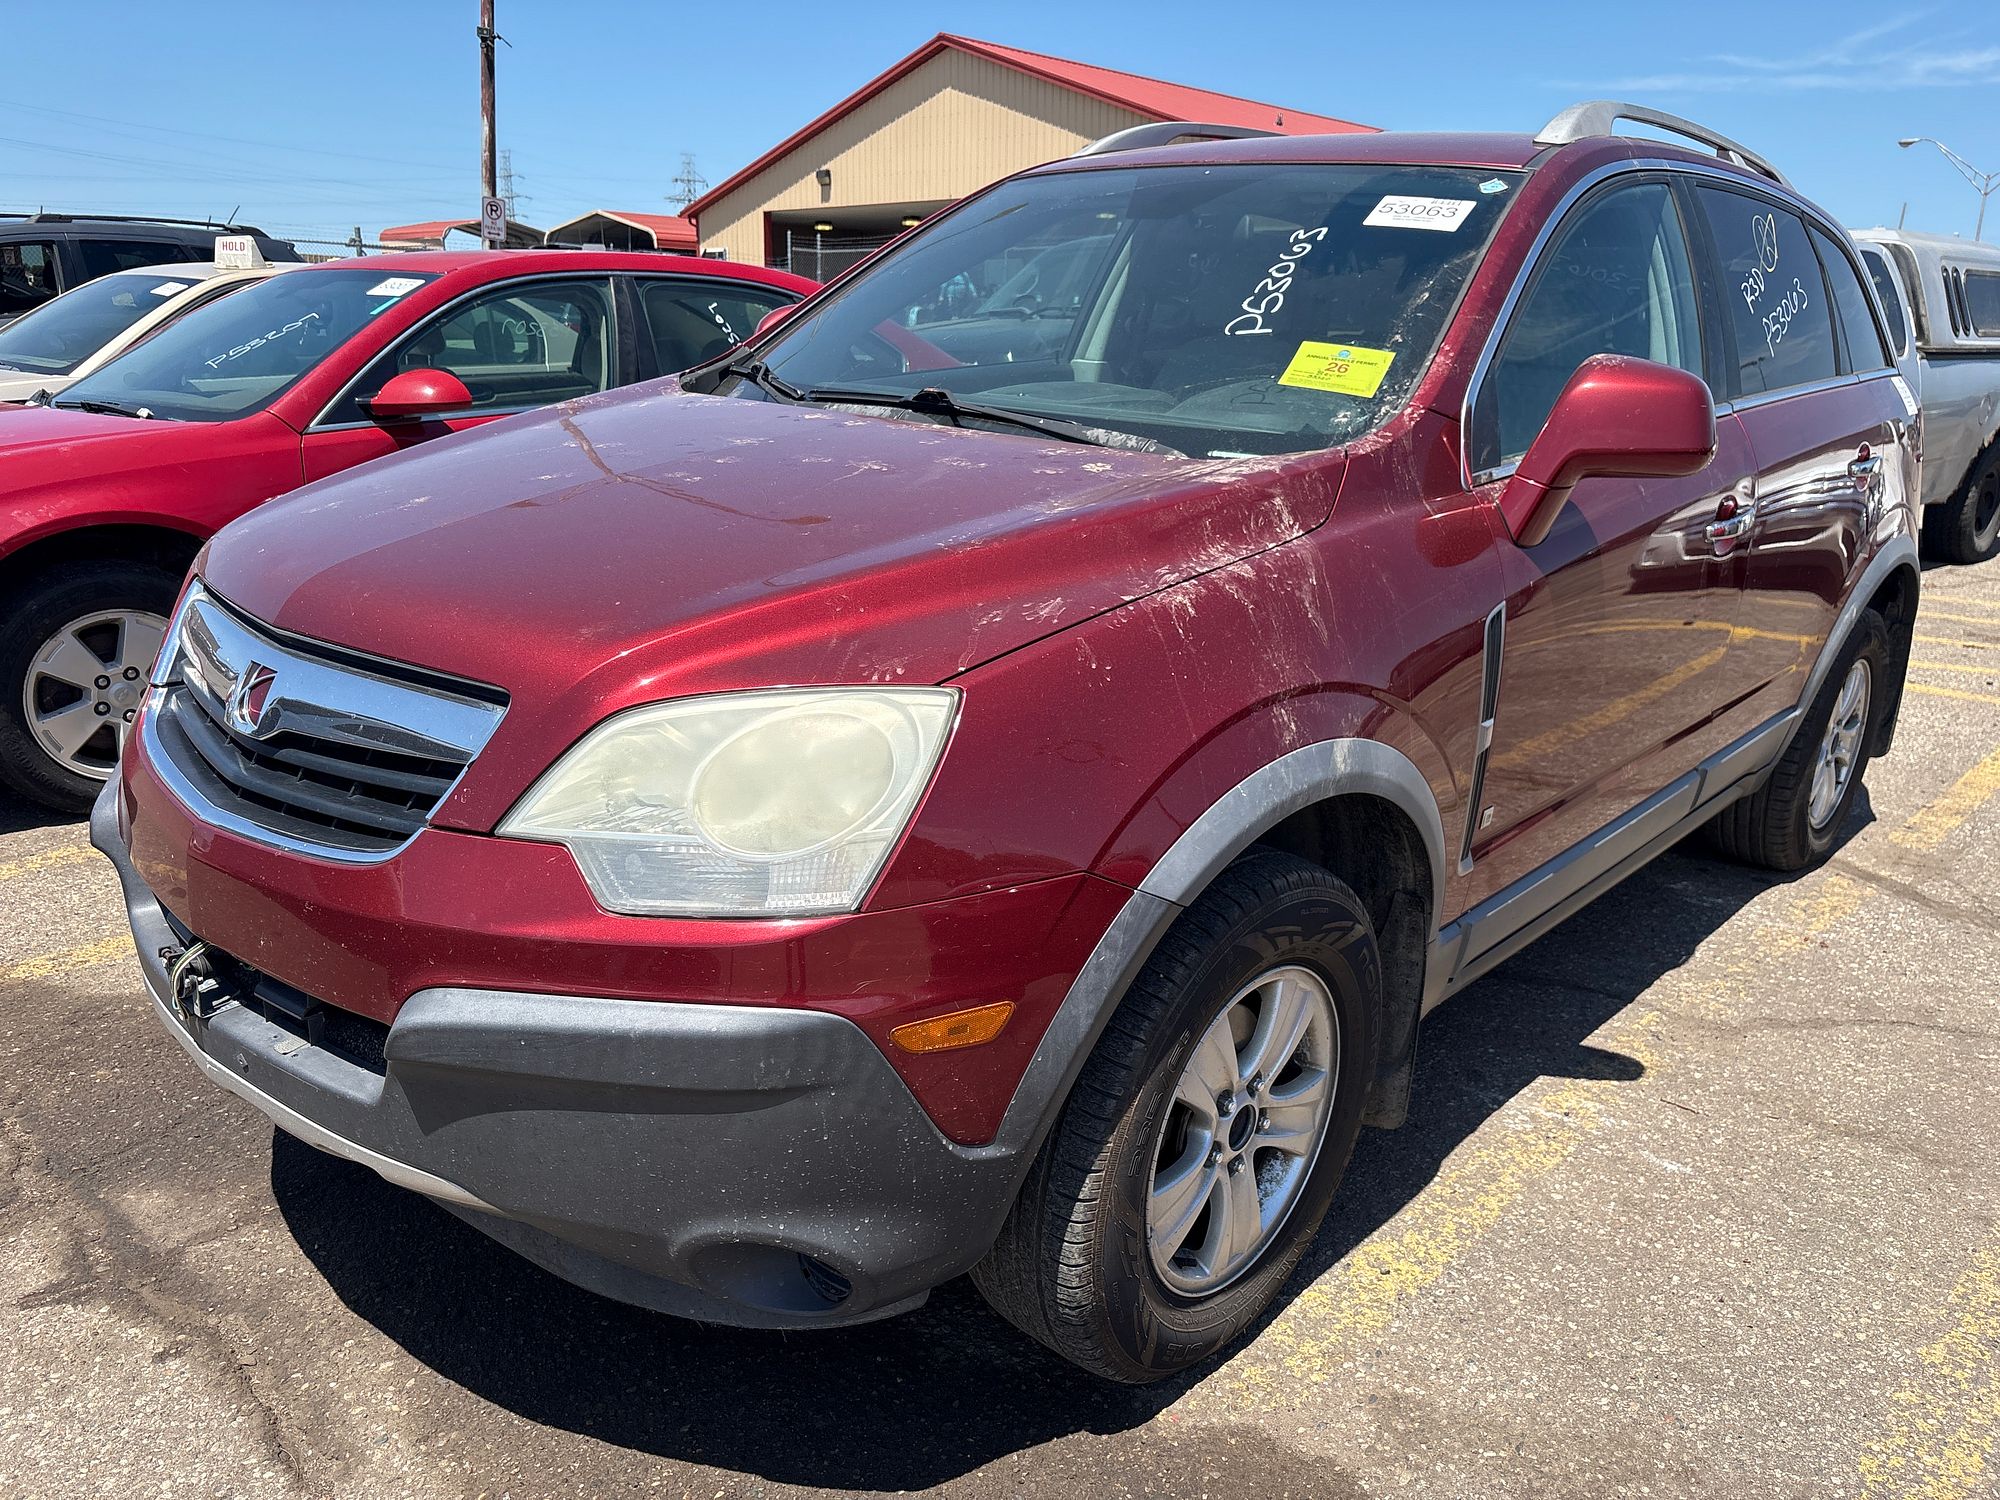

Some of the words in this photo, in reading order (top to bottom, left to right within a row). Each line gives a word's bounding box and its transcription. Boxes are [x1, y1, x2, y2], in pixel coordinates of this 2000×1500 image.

[1378, 203, 1458, 218] 53063
[222, 241, 246, 252] HOLD
[1762, 277, 1808, 358] P53063
[1324, 362, 1350, 374] 26
